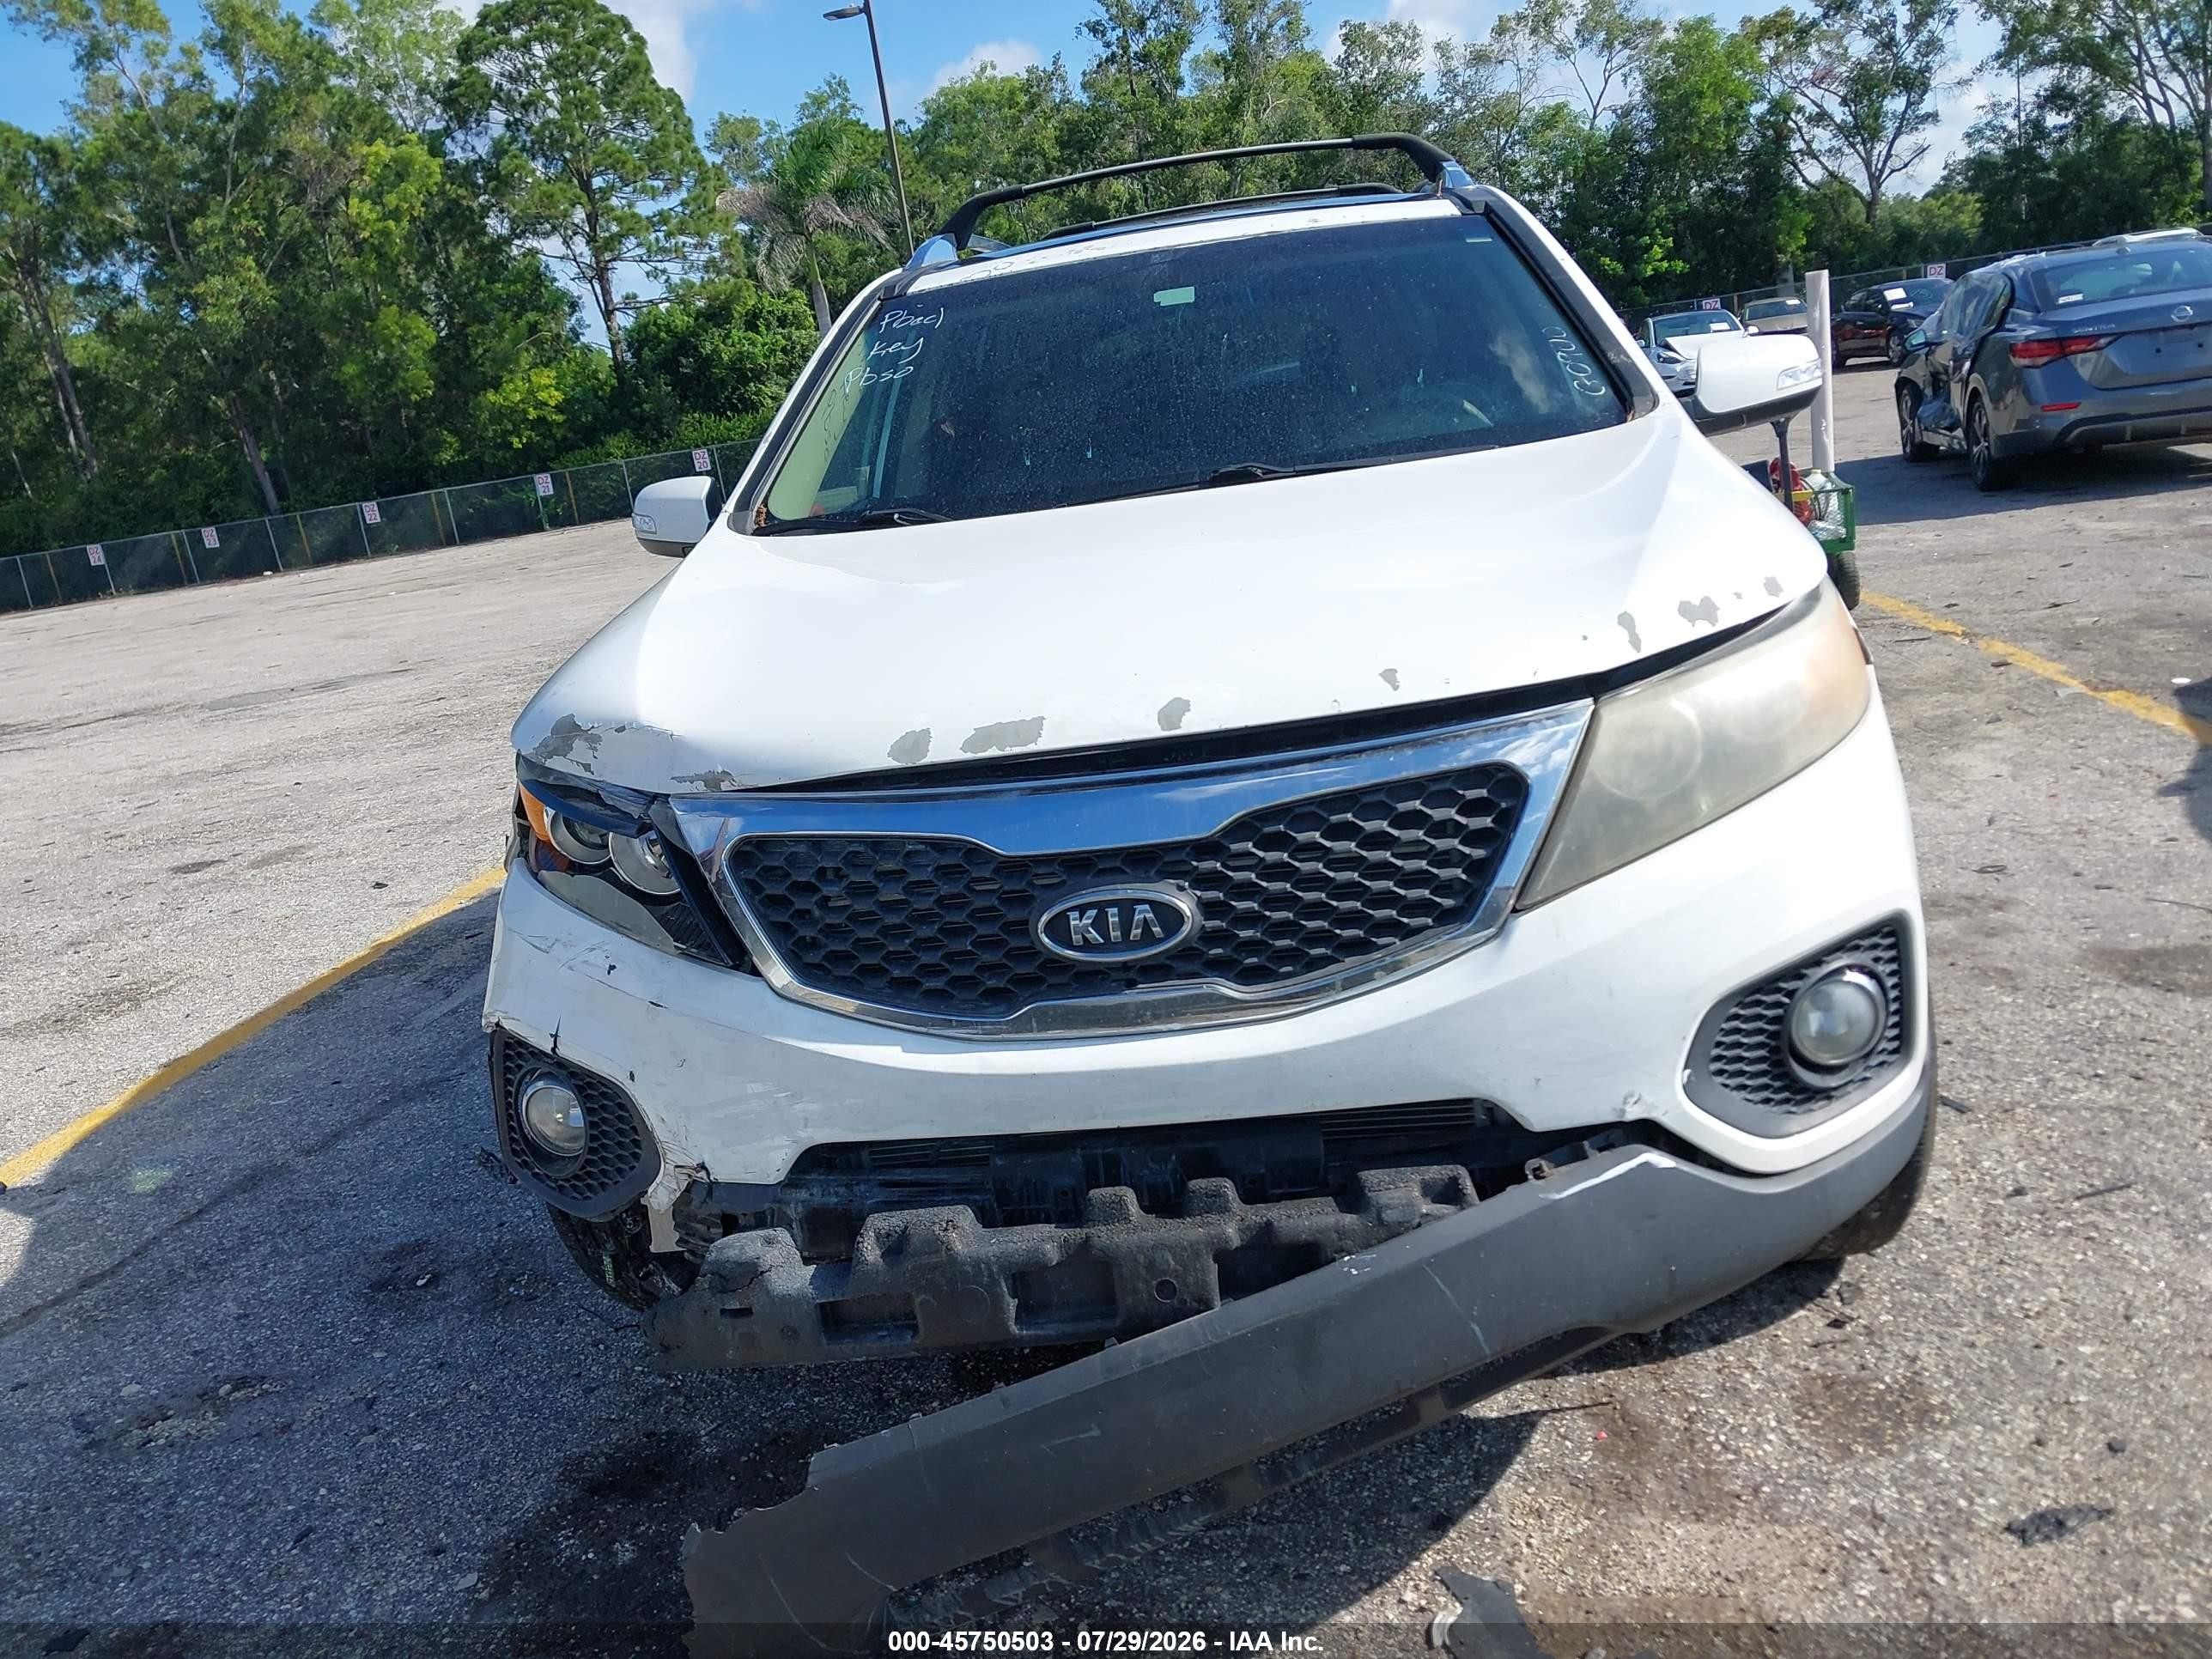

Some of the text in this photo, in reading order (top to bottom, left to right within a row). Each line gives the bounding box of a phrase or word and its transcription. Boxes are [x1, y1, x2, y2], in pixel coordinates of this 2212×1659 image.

[1929, 265, 1945, 276] DZ
[1705, 301, 1719, 309] DZ
[694, 451, 708, 461] DZ
[696, 460, 708, 470] 20
[538, 475, 550, 485] DZ
[541, 485, 550, 494] 21
[363, 503, 377, 514] DZ
[367, 513, 379, 521] 22
[1066, 903, 1165, 946] KIA
